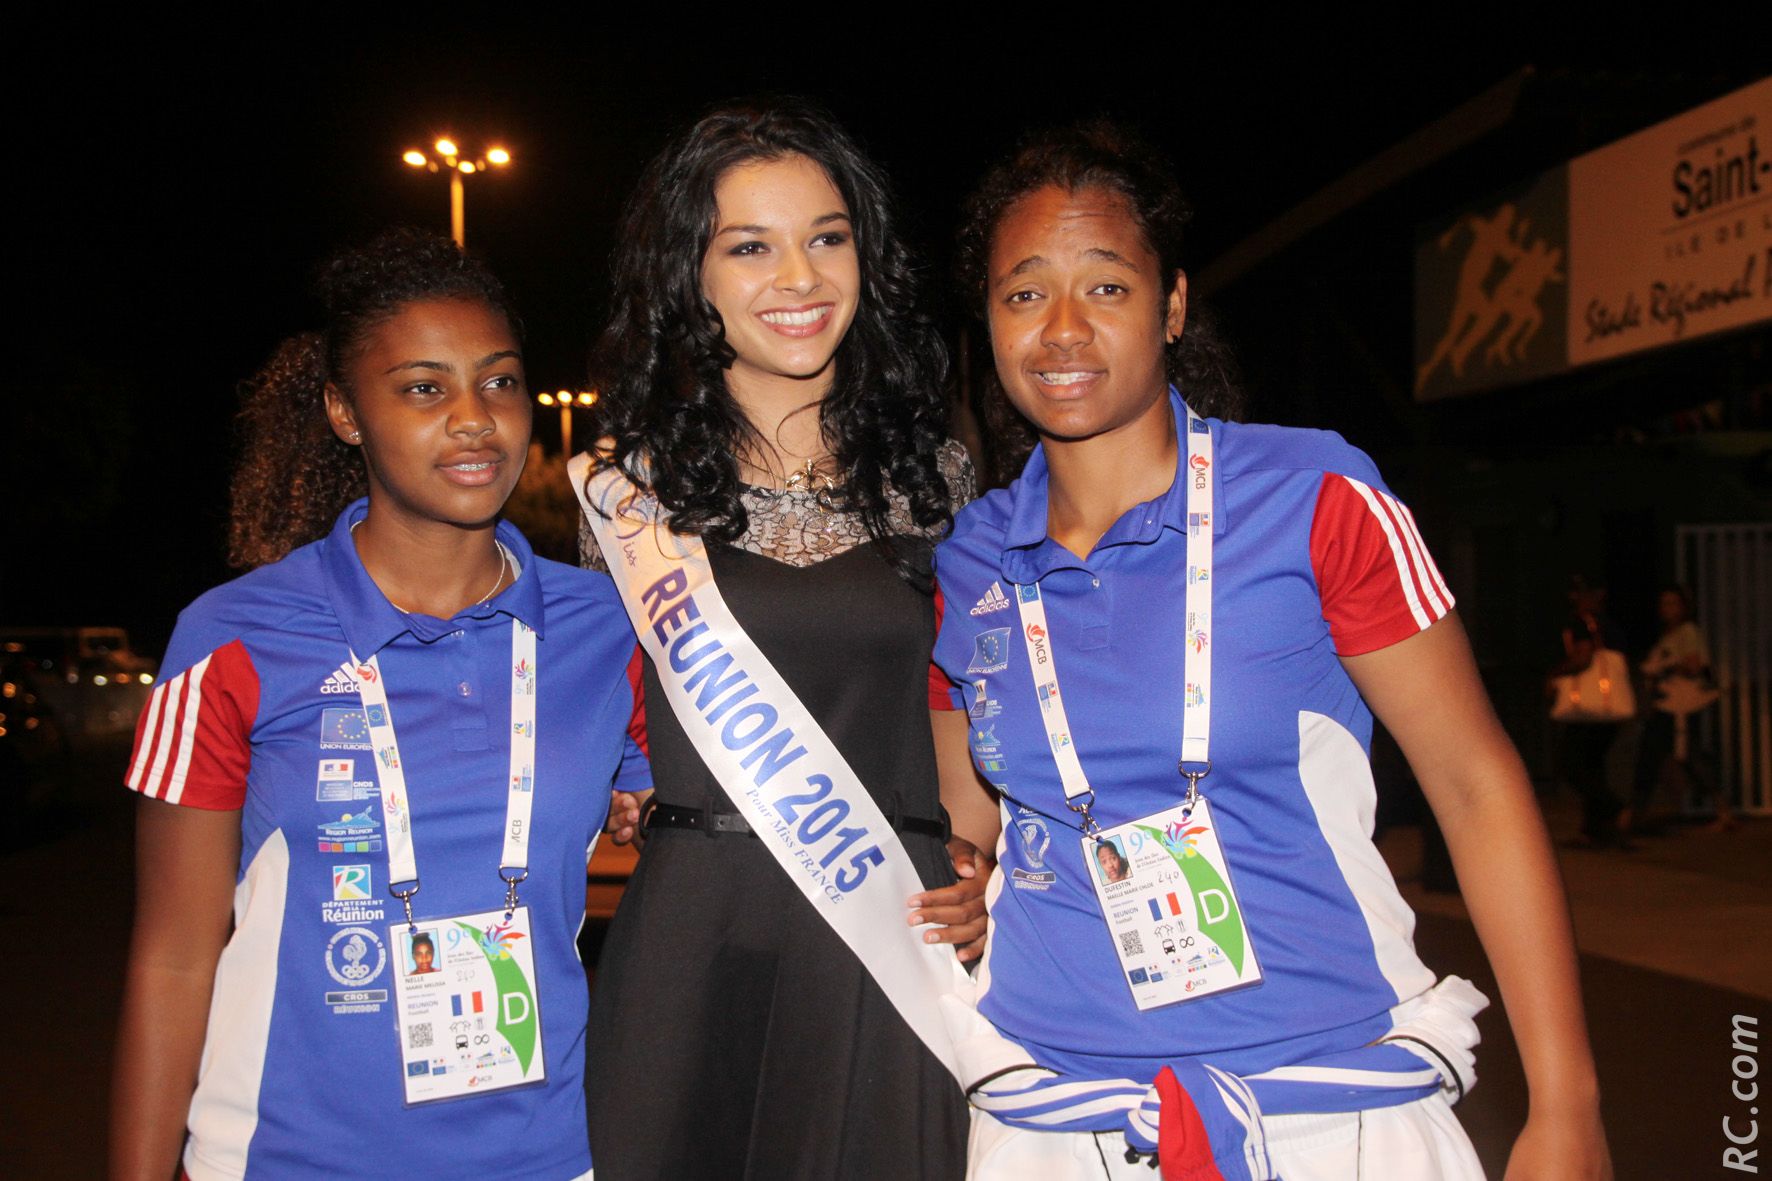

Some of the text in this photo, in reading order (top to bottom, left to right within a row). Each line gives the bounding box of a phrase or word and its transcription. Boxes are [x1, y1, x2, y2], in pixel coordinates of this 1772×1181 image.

[1195, 467, 1206, 490] MCB
[970, 598, 1010, 616] adidas
[1033, 637, 1047, 666] MCB
[320, 681, 361, 694] adid
[640, 566, 886, 895] REUNION 2015
[746, 788, 845, 905] Pour Miss FRANCE
[1104, 880, 1132, 894] DUFESTIN
[322, 907, 385, 922] Réunion
[1198, 889, 1229, 924] D
[343, 993, 369, 1002] CROS
[503, 991, 530, 1026] D
